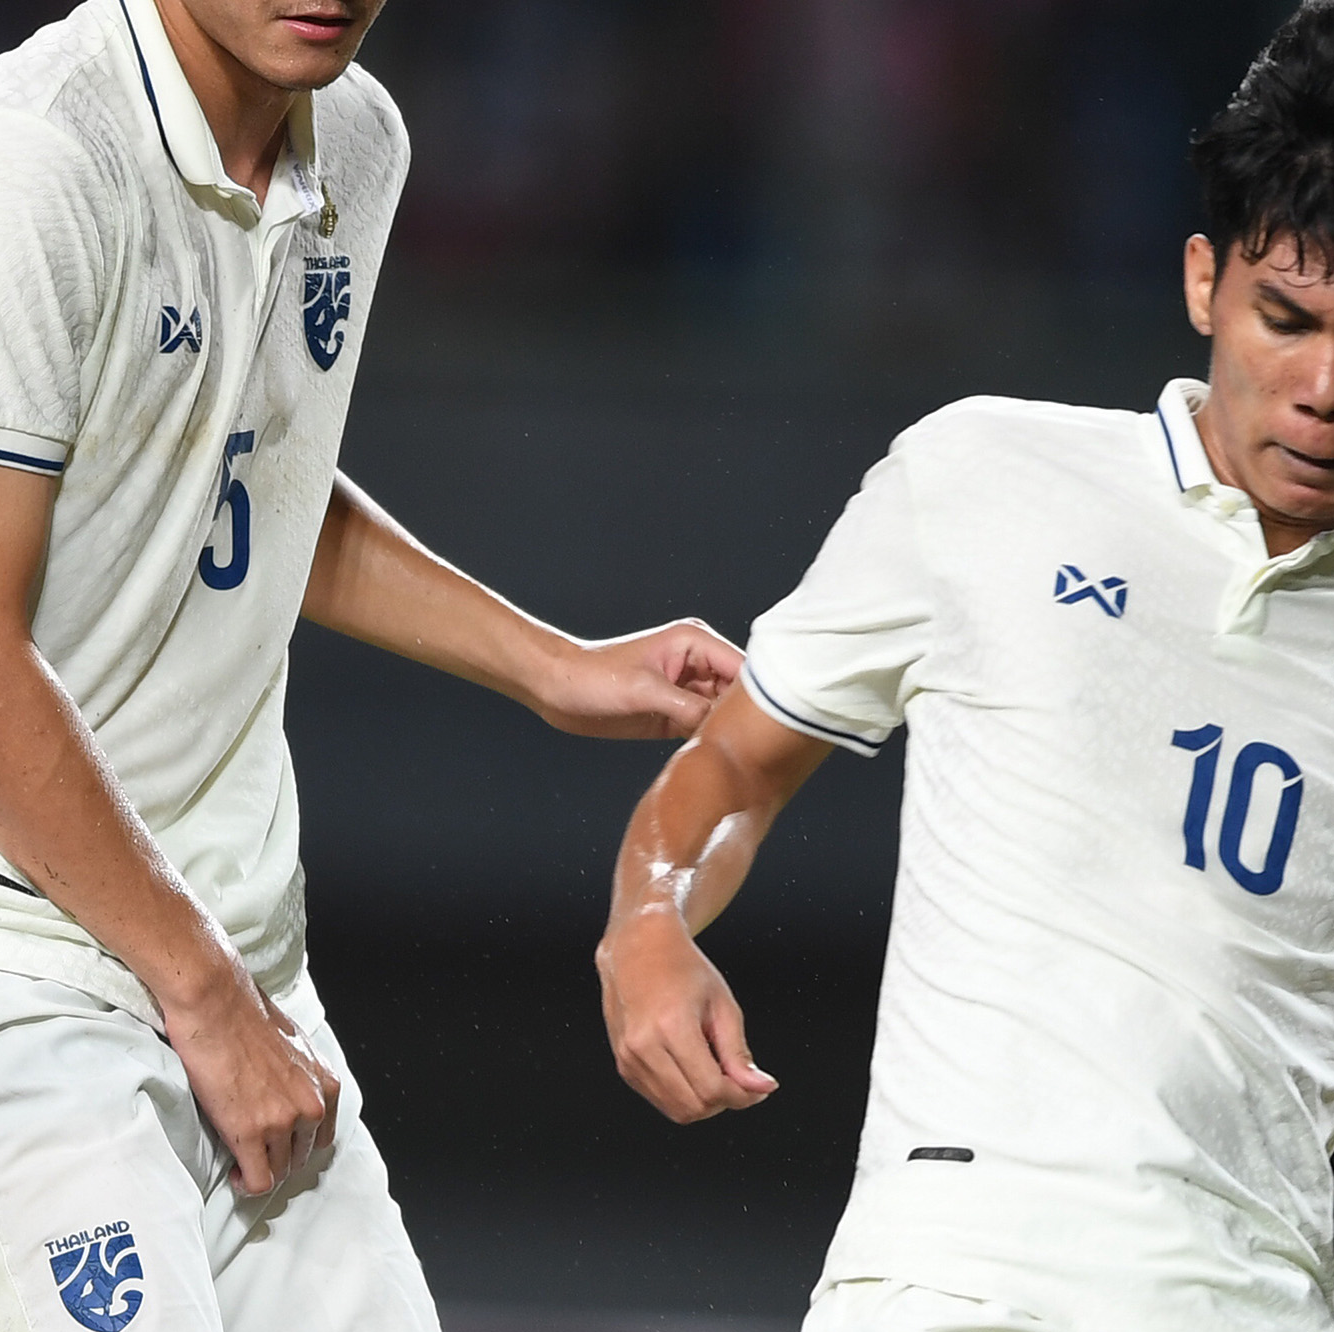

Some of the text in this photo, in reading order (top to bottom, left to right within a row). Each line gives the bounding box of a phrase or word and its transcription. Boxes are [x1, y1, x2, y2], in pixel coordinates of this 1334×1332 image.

[198, 430, 255, 591] 5
[1171, 723, 1305, 896] 10
[44, 1220, 130, 1256] THAILAND
